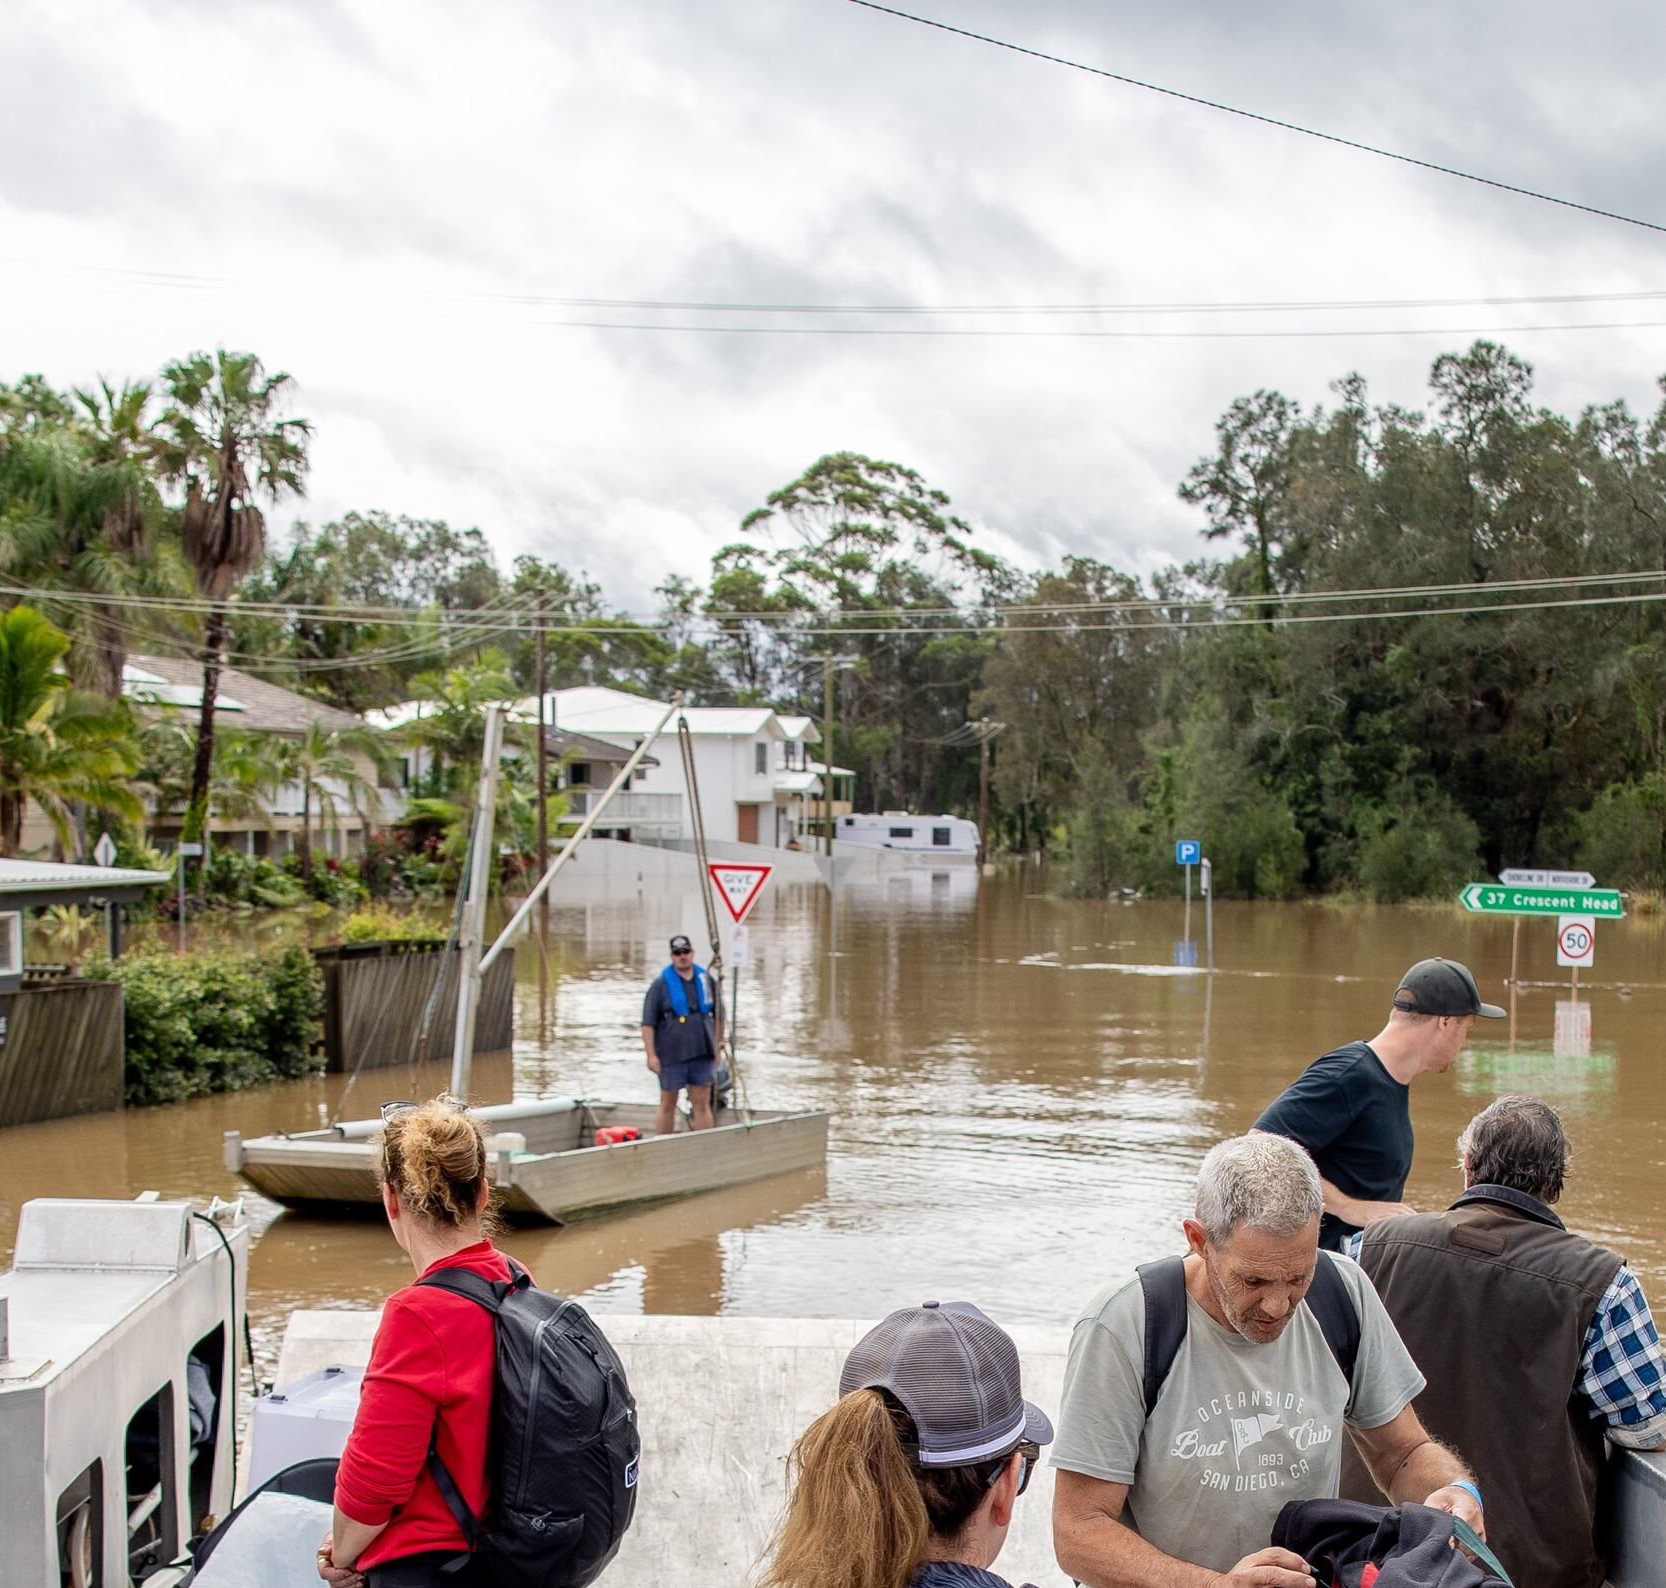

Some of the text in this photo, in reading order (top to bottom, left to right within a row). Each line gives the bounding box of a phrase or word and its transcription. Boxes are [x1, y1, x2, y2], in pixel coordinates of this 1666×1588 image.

[1181, 844, 1194, 860] P
[723, 873, 753, 885] GIVE
[1487, 892, 1618, 910] 37 Crescent Head
[1566, 933, 1588, 949] 50
[1197, 1390, 1305, 1423] OCEANSIDE
[1170, 1428, 1228, 1460] Boat
[1288, 1418, 1332, 1451] Club
[1258, 1453, 1284, 1466] 1893
[1200, 1458, 1310, 1492] SAN DIEGO, CA
